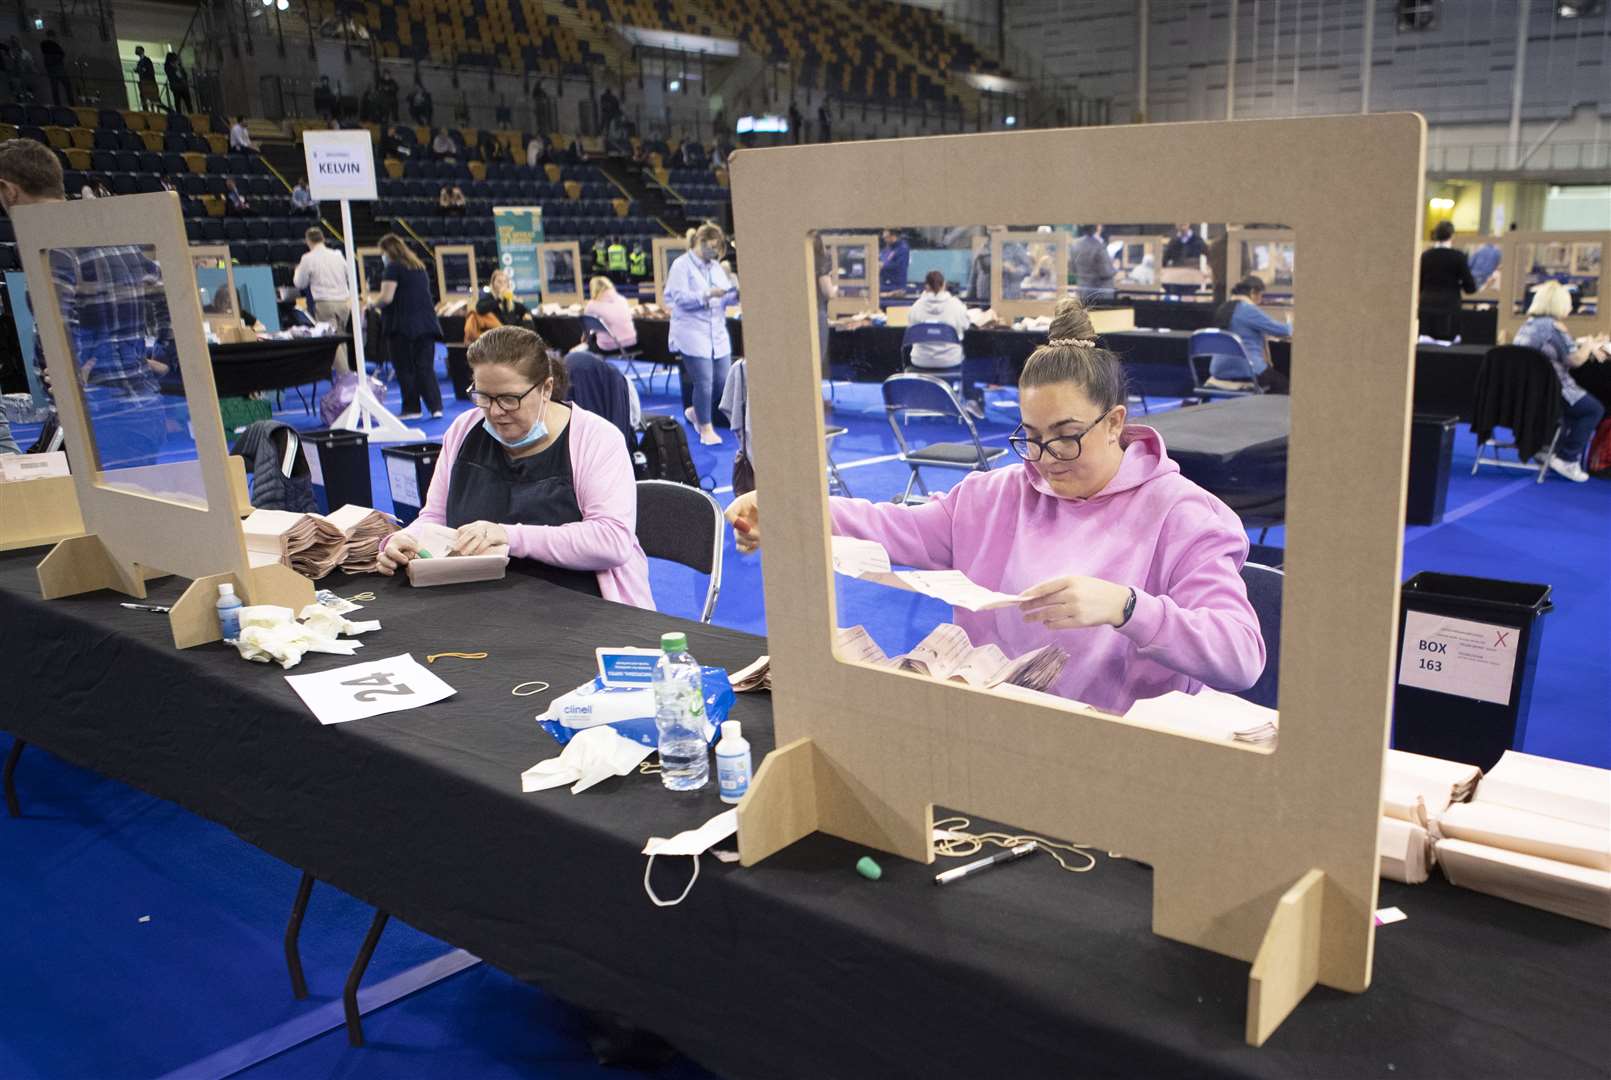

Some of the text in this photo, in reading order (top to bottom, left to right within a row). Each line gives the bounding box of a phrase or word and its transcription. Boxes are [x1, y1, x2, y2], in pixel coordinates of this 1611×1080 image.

[319, 162, 360, 175] KELVIN
[1419, 639, 1448, 655] BOX
[1419, 658, 1442, 672] 163
[340, 672, 416, 702] 24
[564, 704, 593, 714] clinell
